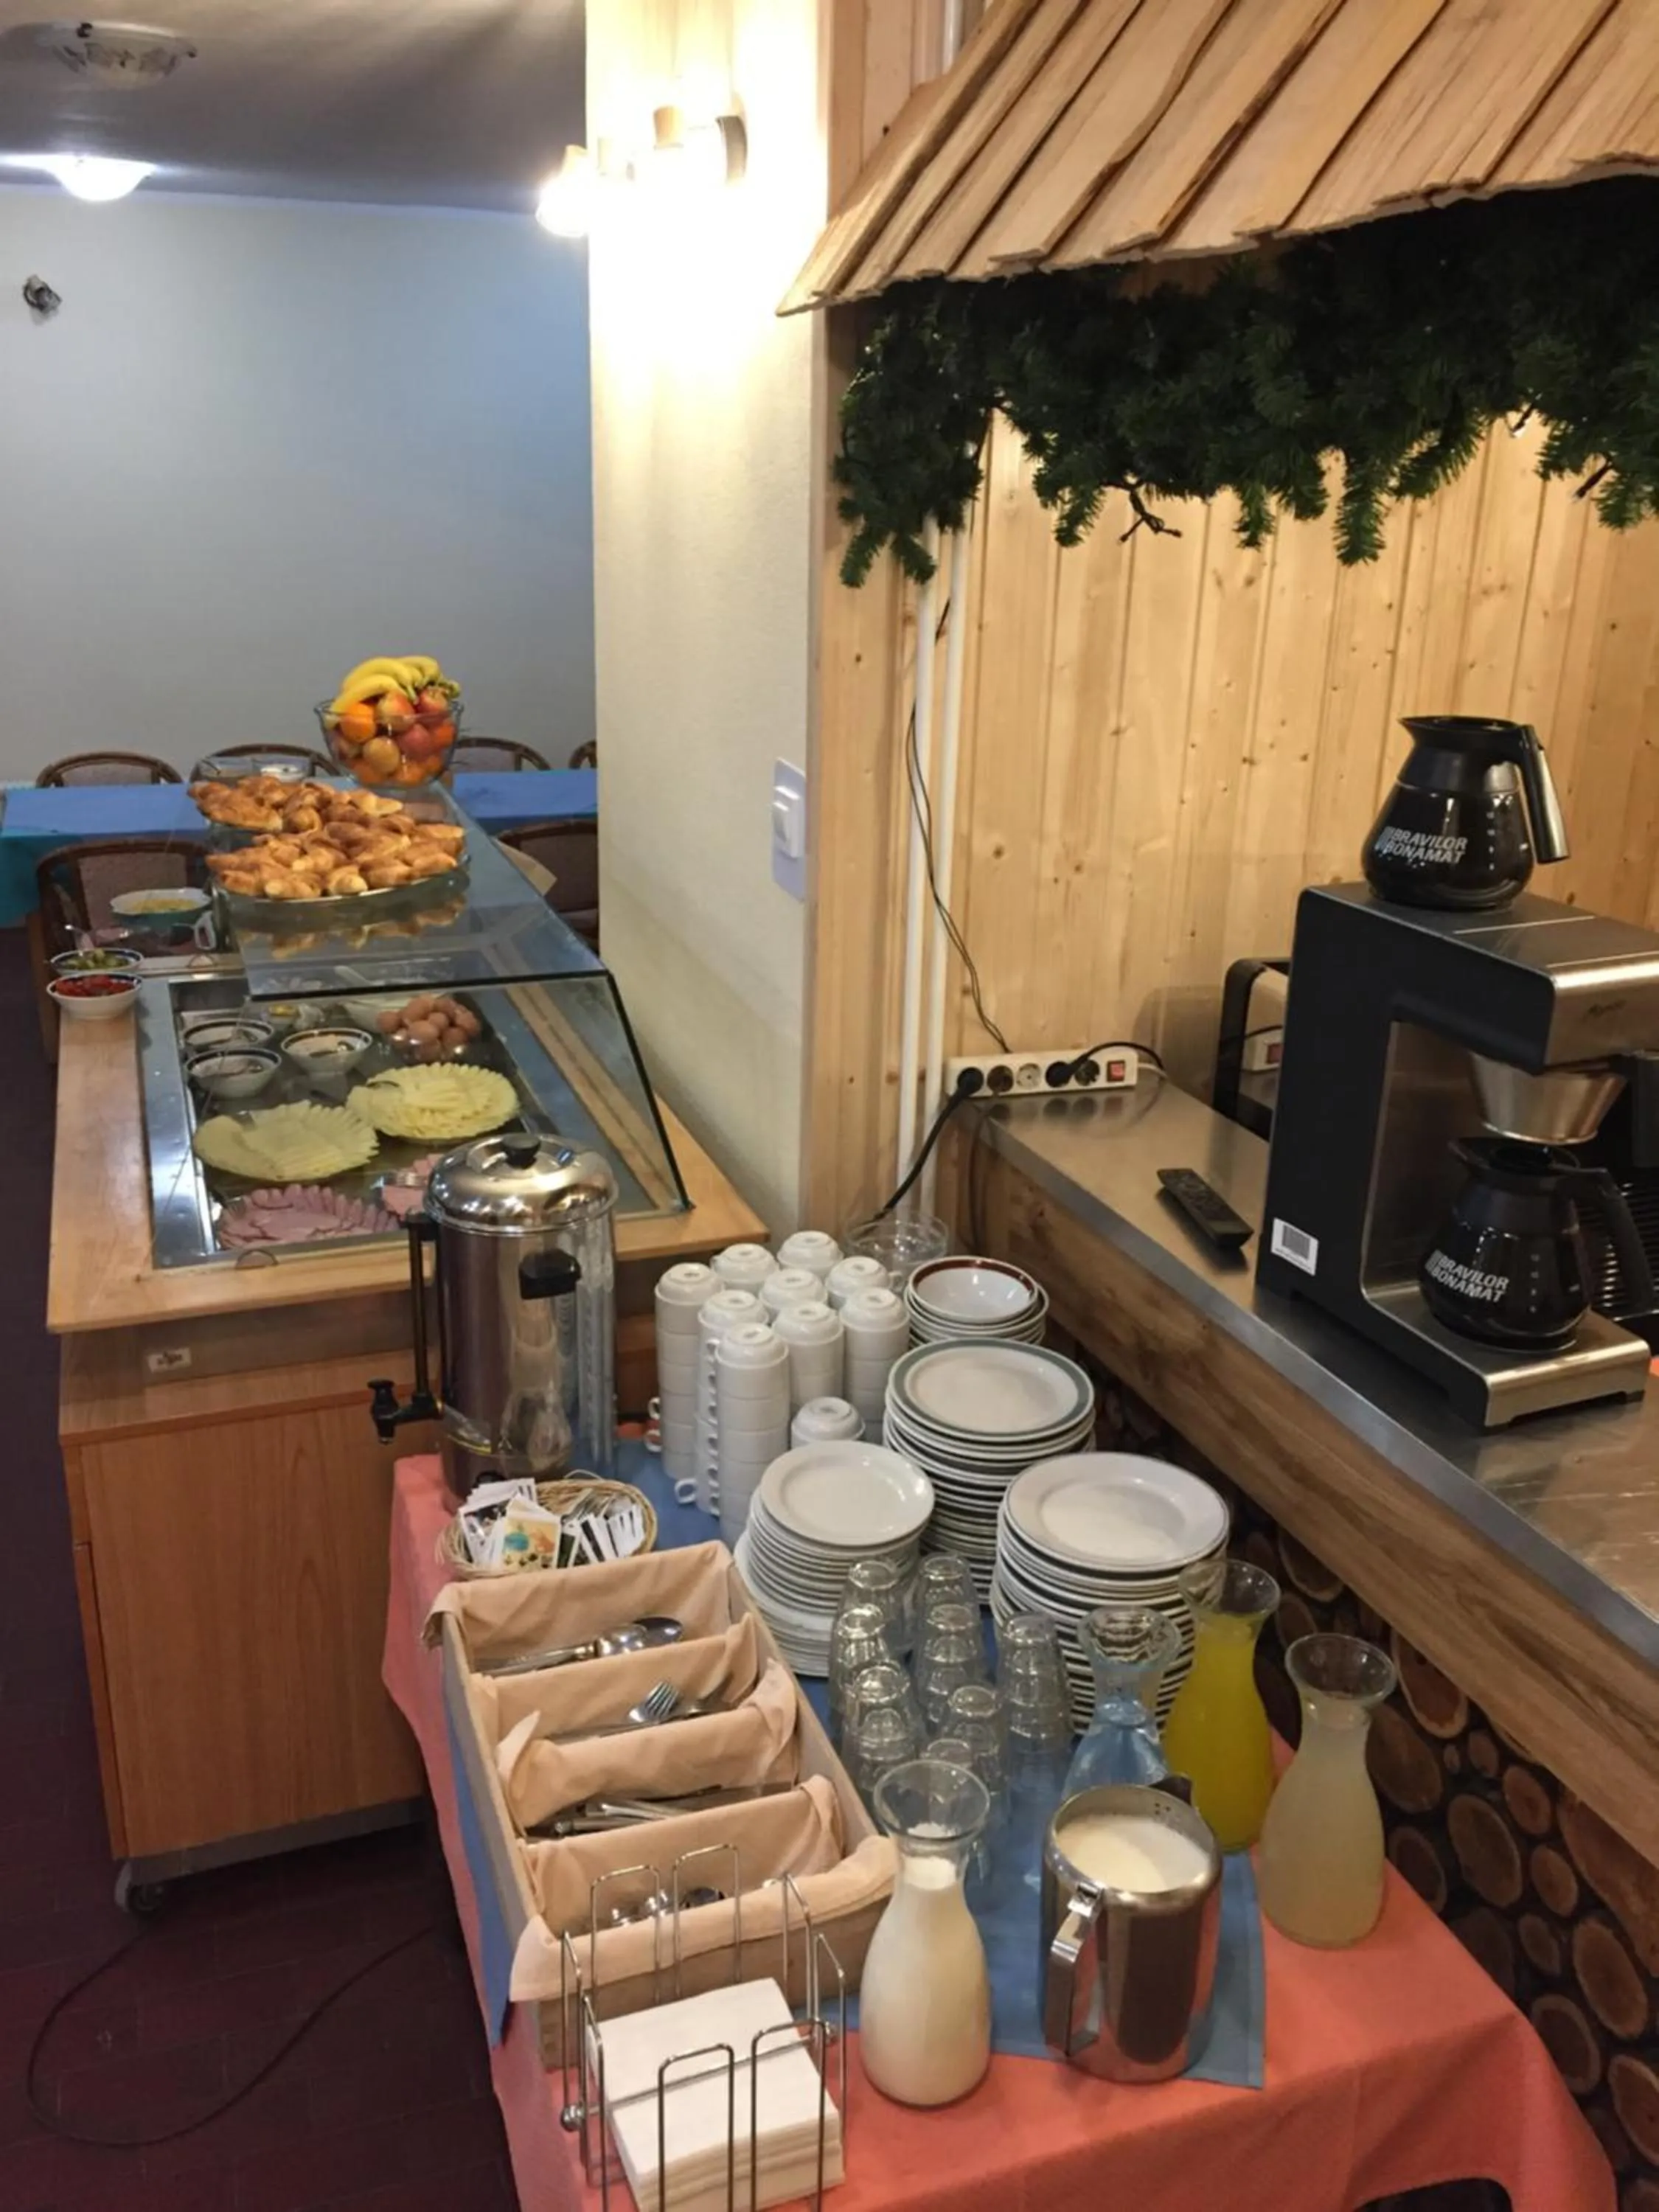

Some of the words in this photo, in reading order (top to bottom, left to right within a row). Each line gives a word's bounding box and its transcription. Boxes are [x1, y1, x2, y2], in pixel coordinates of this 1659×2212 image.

[1382, 841, 1466, 863] BONAMAT
[1391, 829, 1468, 849] BRAVILOR
[1430, 1266, 1506, 1302] BONAMAT
[1439, 1255, 1509, 1290] BRAVILOR
